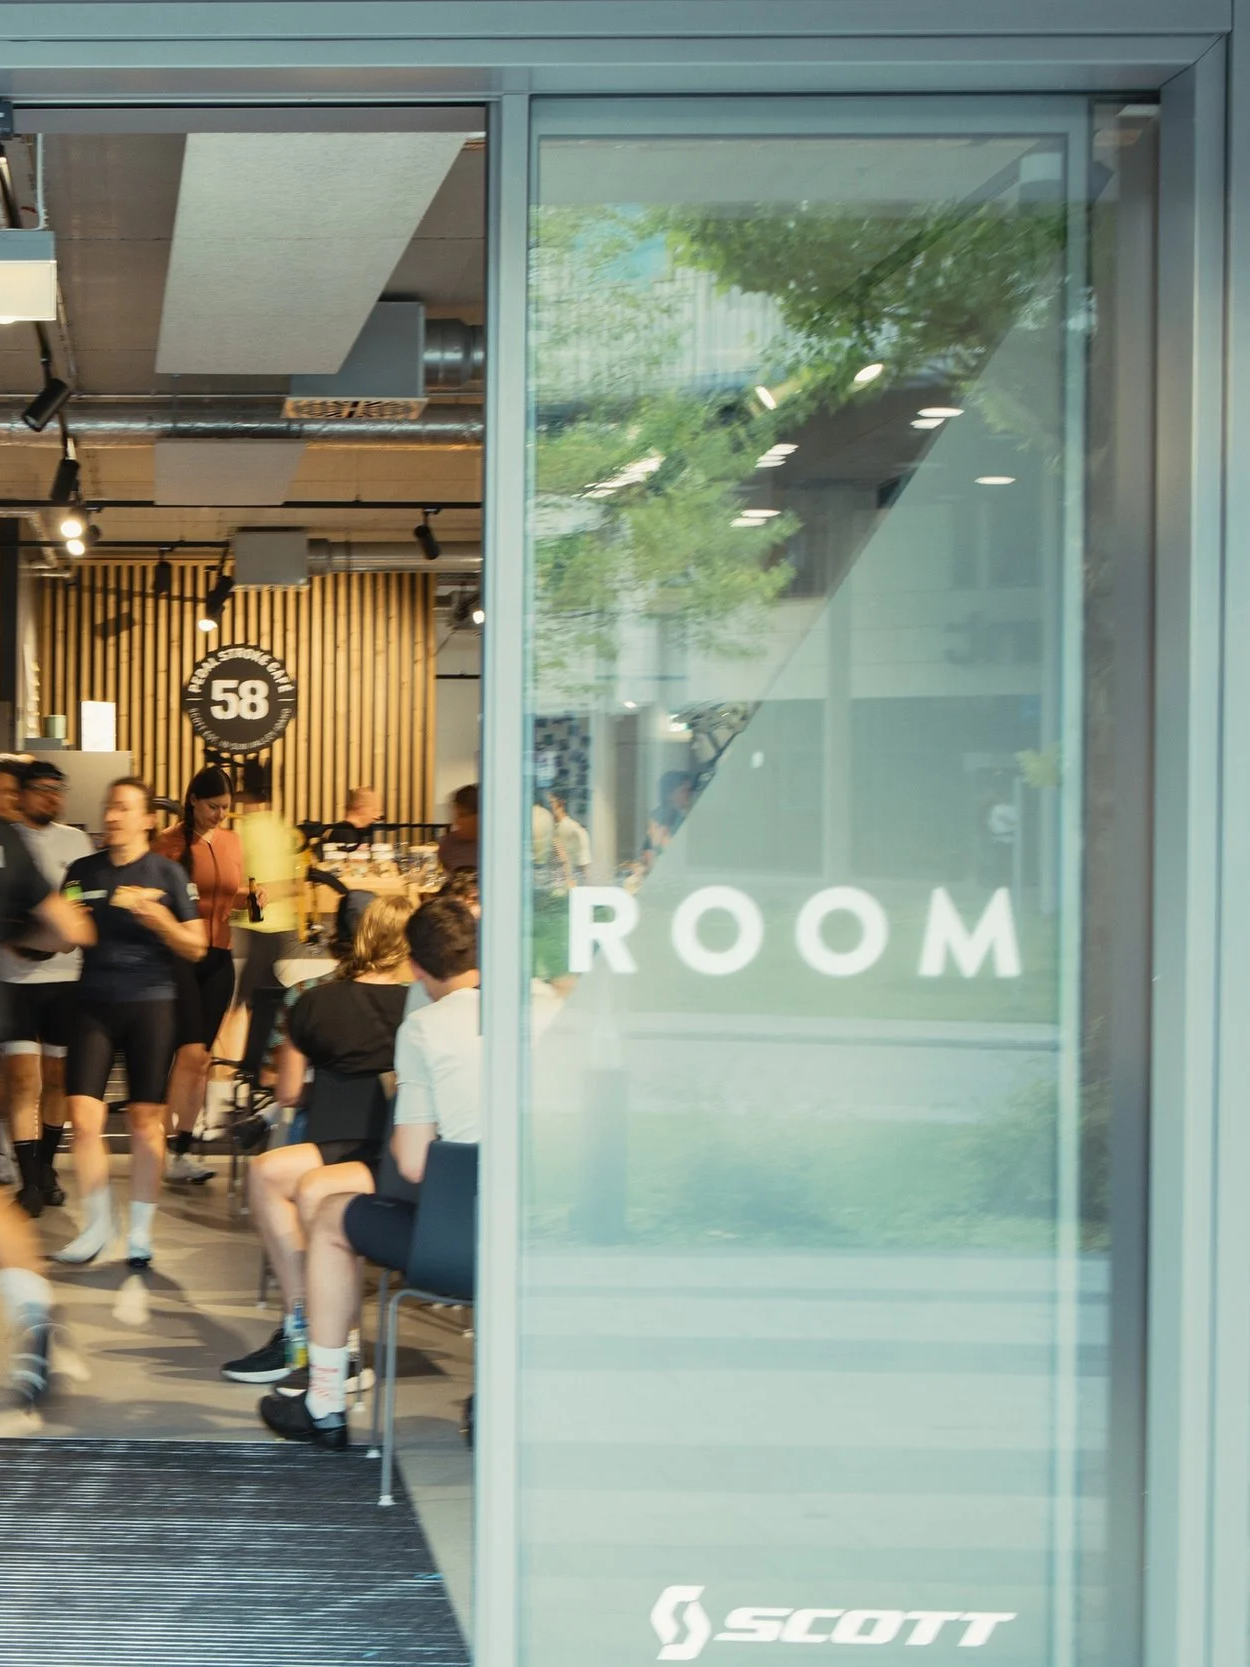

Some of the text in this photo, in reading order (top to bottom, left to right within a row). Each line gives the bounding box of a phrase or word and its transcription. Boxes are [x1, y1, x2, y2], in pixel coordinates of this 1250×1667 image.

[210, 679, 269, 720] 58
[568, 885, 1022, 978] ROOM
[713, 1607, 1018, 1647] SCOTT
